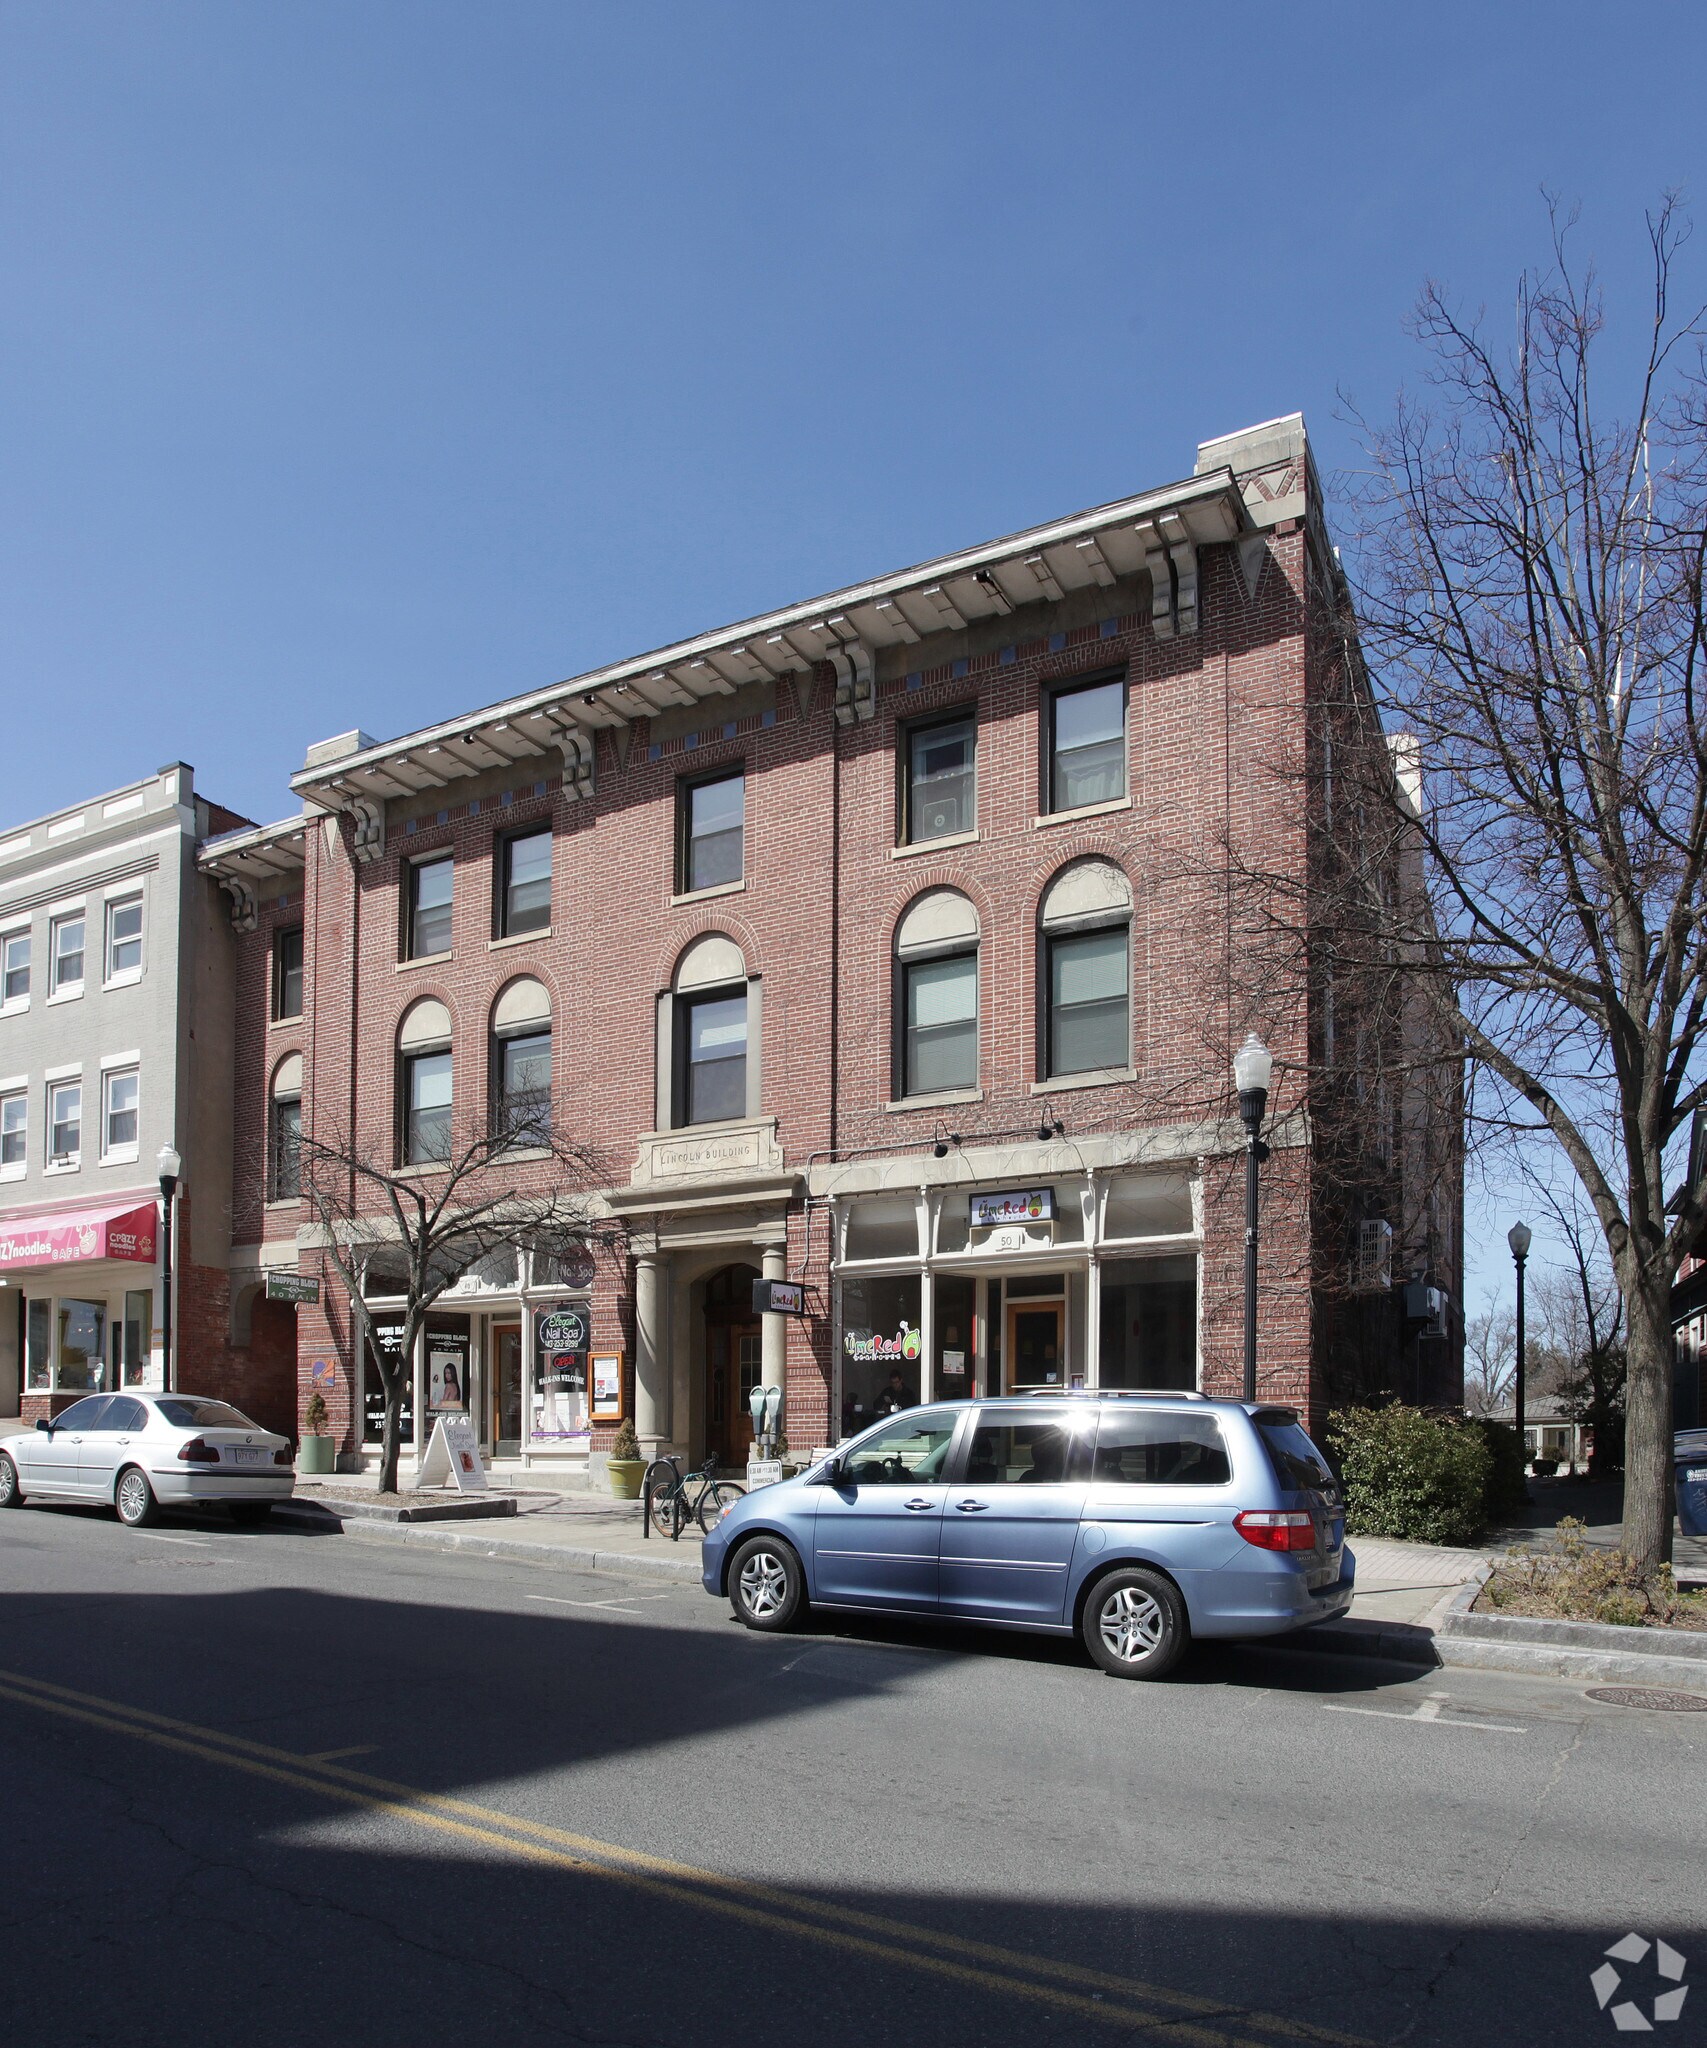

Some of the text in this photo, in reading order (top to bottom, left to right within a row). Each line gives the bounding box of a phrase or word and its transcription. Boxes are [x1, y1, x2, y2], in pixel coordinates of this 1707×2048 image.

[661, 1145, 750, 1164] LINCOLN BUILDING
[109, 1241, 136, 1251] noodles
[1001, 1236, 1012, 1246] 50
[13, 1241, 52, 1257] noodles
[51, 1247, 80, 1260] CAFE
[288, 1293, 317, 1302] MAIN
[548, 1315, 577, 1328] Elegant
[545, 1327, 580, 1341] Nail Spa
[554, 1355, 576, 1366] OPEN
[560, 1374, 585, 1385] WELCOME
